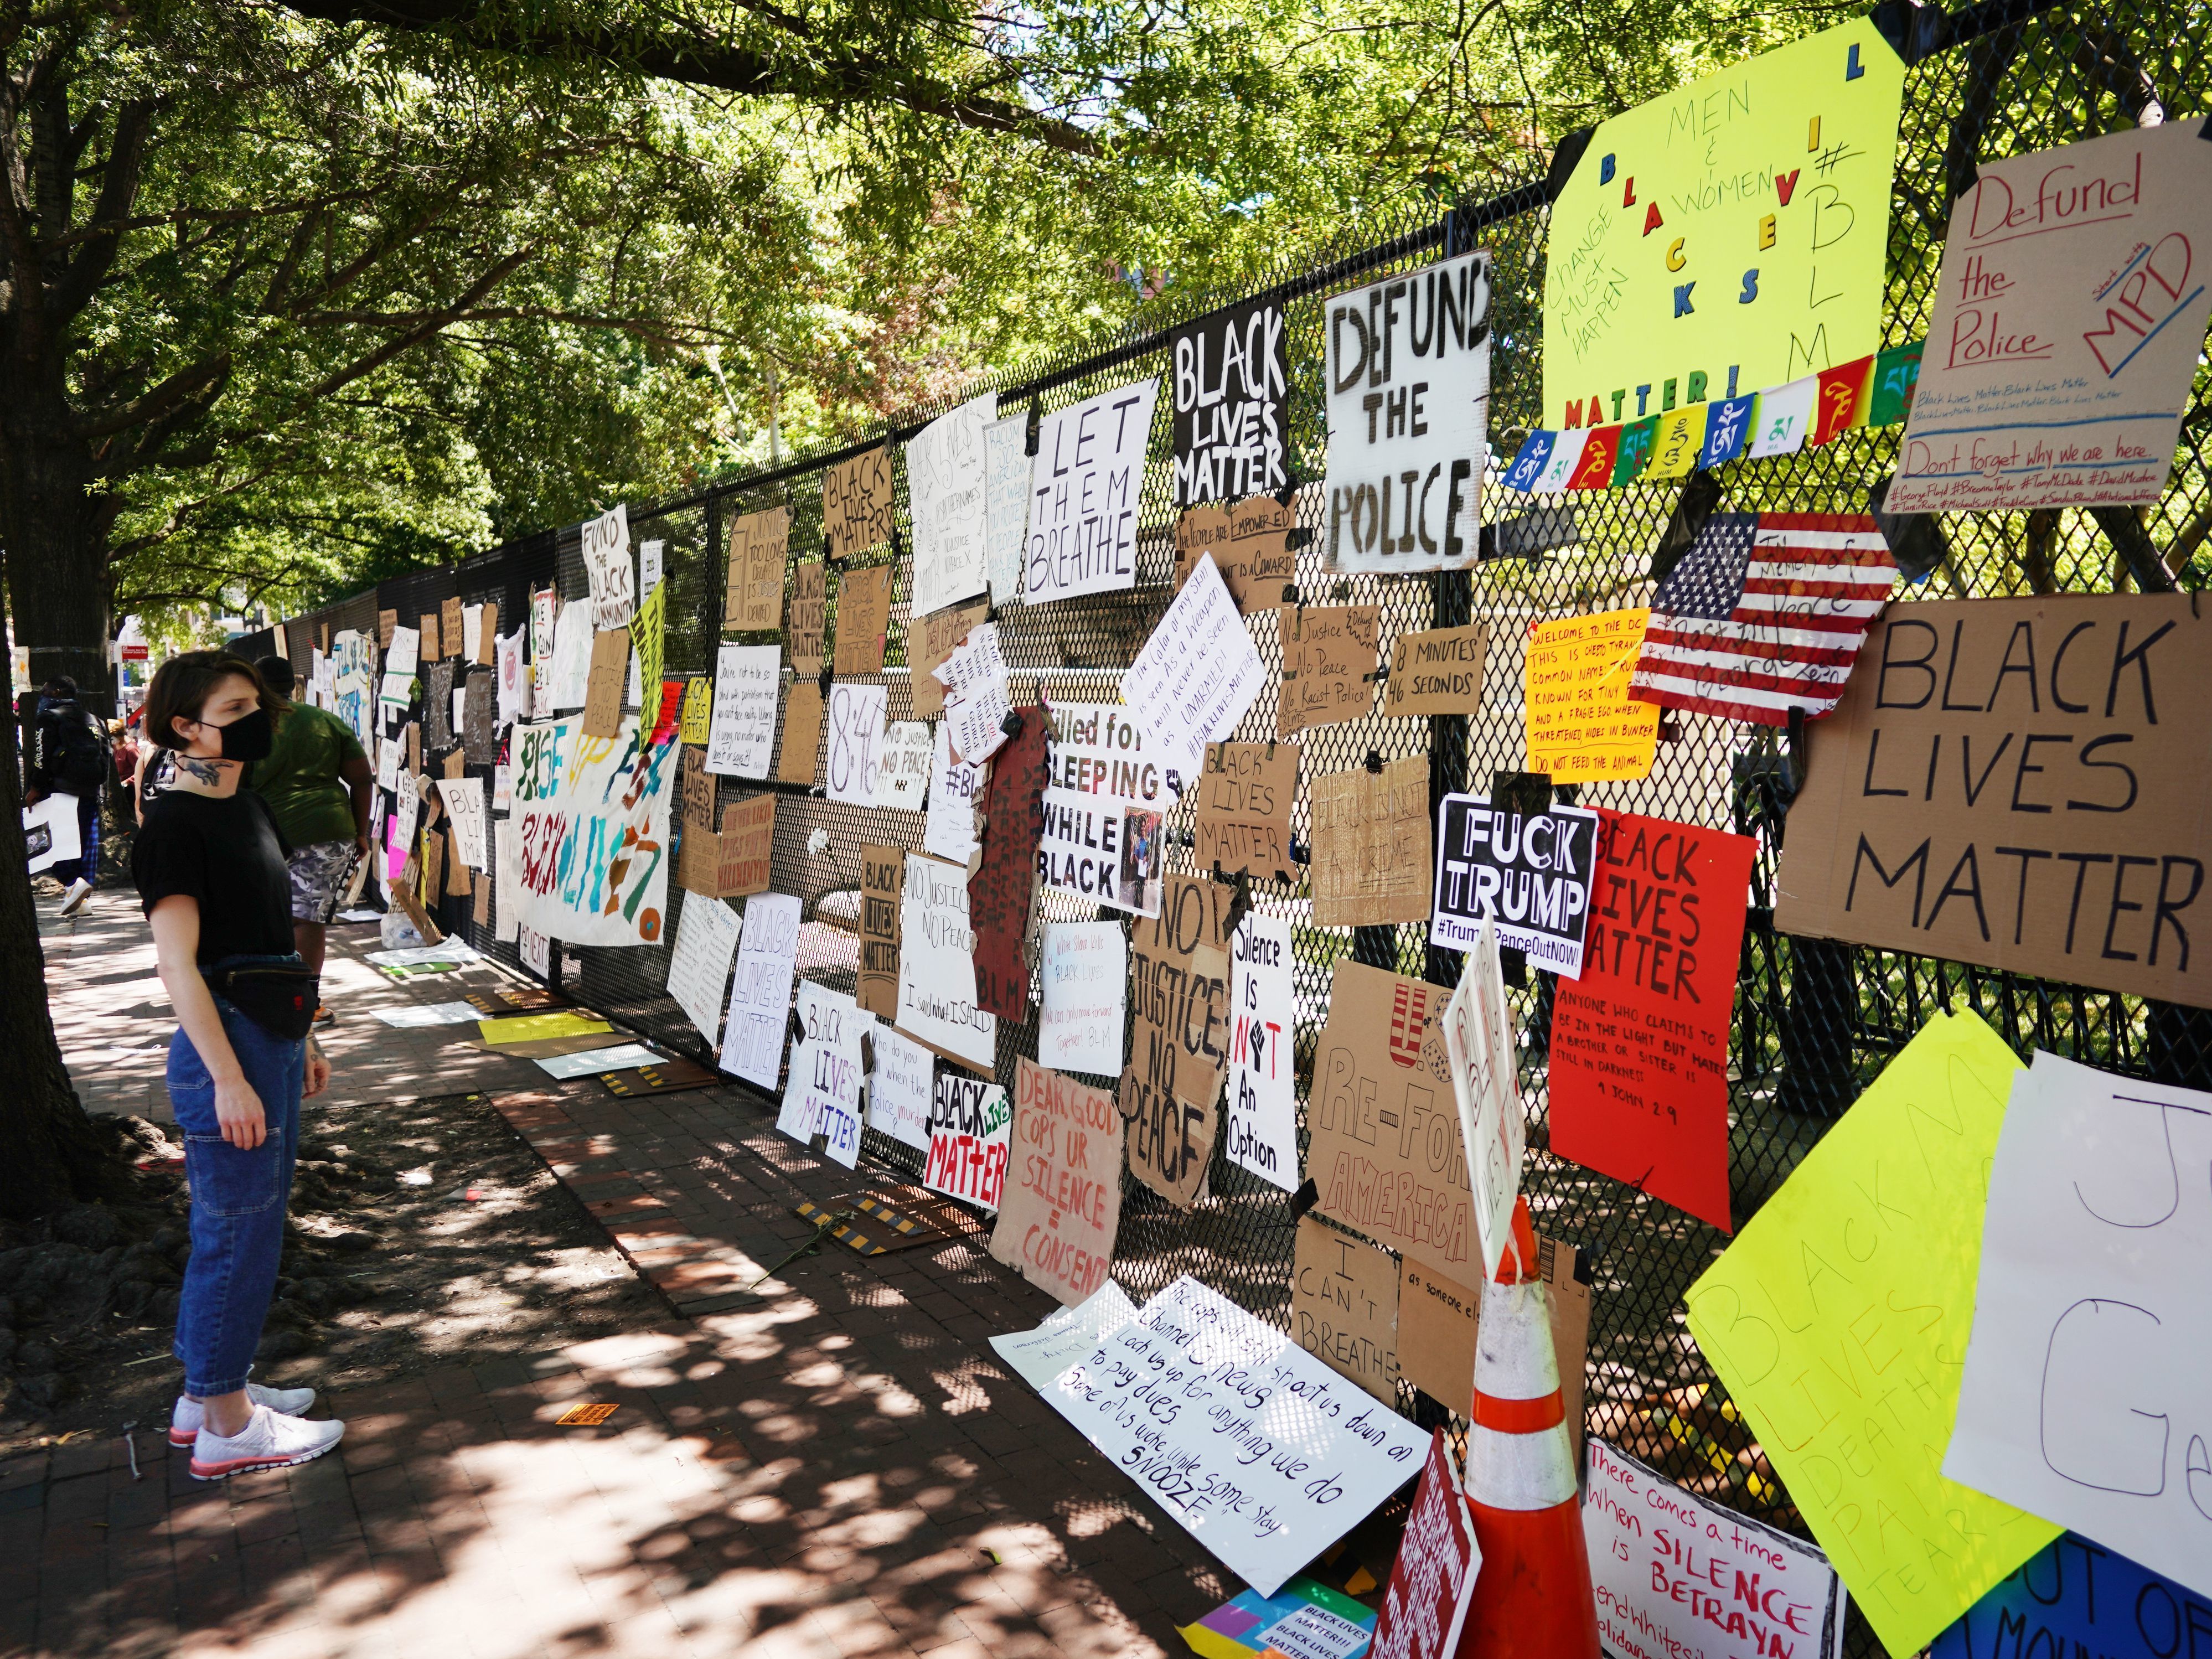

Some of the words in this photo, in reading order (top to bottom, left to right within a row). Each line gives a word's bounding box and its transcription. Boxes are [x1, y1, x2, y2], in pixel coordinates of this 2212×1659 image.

[1667, 80, 1750, 148] MEN
[1672, 164, 1773, 215] WOMEN
[1971, 152, 2141, 239] Defund
[1959, 256, 2016, 299] the
[1334, 259, 1492, 395] DEFUND
[1572, 267, 1628, 363] HAPPEN
[1949, 309, 2054, 368] Police
[2084, 232, 2191, 375] MPD
[1177, 306, 1285, 414] BLACK
[1192, 401, 1278, 449] LIVES
[1363, 382, 1428, 443] THE
[1053, 396, 1140, 478] LET
[830, 455, 885, 508] BLACK
[1037, 465, 1129, 525] THEM
[1174, 441, 1286, 505] MATTER
[844, 493, 875, 521] LIVES
[1330, 460, 1471, 562] POLICE
[583, 515, 618, 557] FUND
[750, 545, 765, 562] TOO
[766, 539, 784, 562] LONG
[1030, 510, 1131, 592] BREATHE
[592, 565, 626, 604] BLACK
[595, 554, 606, 567] THE
[793, 571, 825, 600] BLACK
[843, 571, 874, 609] BLACK
[593, 600, 635, 626] COMMUNITY
[792, 602, 824, 629] LIVES
[845, 608, 874, 637] LIVES
[1304, 616, 1341, 644] Justice
[1353, 611, 1374, 626] Defund
[1534, 627, 1584, 645] WELCOME
[1591, 626, 1599, 636] TO
[1605, 619, 1620, 632] THE
[1629, 619, 1641, 629] DC
[966, 658, 975, 680] WHY
[974, 648, 984, 676] KNOW
[1295, 646, 1313, 677] No
[1316, 648, 1348, 676] Peace
[1397, 644, 1407, 672] 8
[1415, 636, 1477, 664] MINUTES
[1529, 652, 1558, 668] THIS
[1569, 649, 1579, 660] IS
[1532, 670, 1573, 685] COMMON
[1579, 665, 1607, 681] NAME:
[1695, 644, 1797, 698] George
[1874, 619, 2177, 724] BLACK
[687, 703, 706, 719] LIVES
[1283, 687, 1294, 711] No
[1302, 681, 1329, 709] Racist
[1388, 678, 1404, 706] 46
[1411, 673, 1474, 695] SECONDS
[1535, 691, 1572, 705] KNOWN
[1578, 689, 1593, 701] FOR
[1599, 685, 1620, 699] TINY
[969, 711, 980, 752] GEORGE
[1534, 728, 1583, 745] THREATENED,
[1585, 727, 1605, 738] HIDES
[1609, 725, 1619, 735] IN
[1622, 724, 1654, 737] BUNKER.
[1536, 715, 1551, 725] AND
[1615, 705, 1641, 715] WHEN
[516, 725, 567, 800] RISE
[902, 750, 925, 775] PEACE
[1206, 748, 1262, 778] BLACK
[1536, 755, 1548, 772] DO
[1553, 753, 1568, 770] NOT
[1572, 754, 1590, 769] FEED
[1593, 754, 1606, 768] THE
[1612, 754, 1642, 771] ANIMAL
[1863, 728, 2138, 813] LIVES
[685, 775, 709, 807] LIVES
[1212, 779, 1274, 815] LIVES
[1041, 801, 1117, 853] WHILE
[1201, 821, 1281, 862] MATTER
[1462, 808, 1580, 875] FUCK
[520, 810, 567, 898] BLACK
[866, 861, 897, 893] BLACK
[1040, 850, 1115, 899] BLACK
[1154, 881, 1204, 955] NO
[1445, 859, 1585, 932] TRUMP
[1845, 832, 2204, 973] MATTER
[530, 932, 549, 969] NEXT?
[743, 902, 795, 958] BLACK
[1236, 916, 1281, 968] Silence
[863, 940, 897, 974] MATTER
[735, 959, 787, 1009] LIVES
[977, 964, 1020, 1017] BLM
[1246, 972, 1258, 1011] Is
[808, 1004, 842, 1046] BLACK
[959, 1000, 991, 1033] SAID
[1559, 990, 1606, 1015] ANYONE
[1614, 1004, 1639, 1022] WHO
[1646, 1014, 1694, 1040] CLAIMS
[1701, 1029, 1716, 1046] TO
[722, 1007, 784, 1078] MATTER
[903, 1053, 918, 1071] you
[1149, 1030, 1175, 1097] NO
[1556, 1049, 1578, 1066] STILL
[1584, 1058, 1594, 1071] IN
[1598, 1061, 1644, 1082] DARKNESS
[1557, 1032, 1563, 1043] A
[1567, 1036, 1608, 1054] BROTHER
[1615, 1044, 1629, 1057] OR
[1639, 1051, 1677, 1075] SISTER
[1686, 1071, 1696, 1083] IS
[1559, 1013, 1570, 1026] BE
[1576, 1018, 1590, 1032] IN
[1596, 1022, 1617, 1037] THE
[1623, 1027, 1655, 1046] LIGHT
[1663, 1040, 1686, 1057] BUT
[1693, 1053, 1726, 1079] HATES
[814, 1050, 857, 1105] LIVES
[885, 1068, 908, 1091] when
[910, 1074, 926, 1098] the
[1239, 1069, 1256, 1112] An
[1612, 1085, 1644, 1108] JOHN
[799, 1097, 856, 1152] MATTER
[934, 1077, 986, 1138] BLACK
[1071, 1087, 1118, 1136] GOOD
[1019, 1109, 1058, 1157] COPS
[1067, 1130, 1088, 1170] UR
[1229, 1115, 1276, 1172] Option
[1021, 1154, 1108, 1231] SILENCE
[1325, 1152, 1468, 1263] AMERICA
[1023, 1224, 1108, 1296] CONSENT
[1335, 1239, 1356, 1281] I
[1688, 1159, 1913, 1388] BLACK
[1299, 1267, 1378, 1321] CAN'T
[1409, 1273, 1420, 1285] as
[1426, 1279, 1462, 1310] someone
[1299, 1311, 1397, 1386] BREATHE
[1754, 1289, 1944, 1454] LIVES
[1208, 1403, 1274, 1466] anything
[1272, 1453, 1309, 1481] we
[1305, 1471, 1343, 1505] do
[1388, 1445, 1414, 1463] on
[1588, 1443, 1639, 1494] There
[1646, 1489, 1697, 1527] comes
[1707, 1523, 1723, 1543] a
[1731, 1526, 1787, 1571] time
[1653, 1529, 1813, 1636] SILENCE
[1275, 1625, 1307, 1643] BLACK
[1307, 1639, 1339, 1659] LIVES
[1295, 1617, 1351, 1648] MATTER!!!
[1305, 1606, 1338, 1624] BLACK
[1338, 1621, 1367, 1640] LIVES
